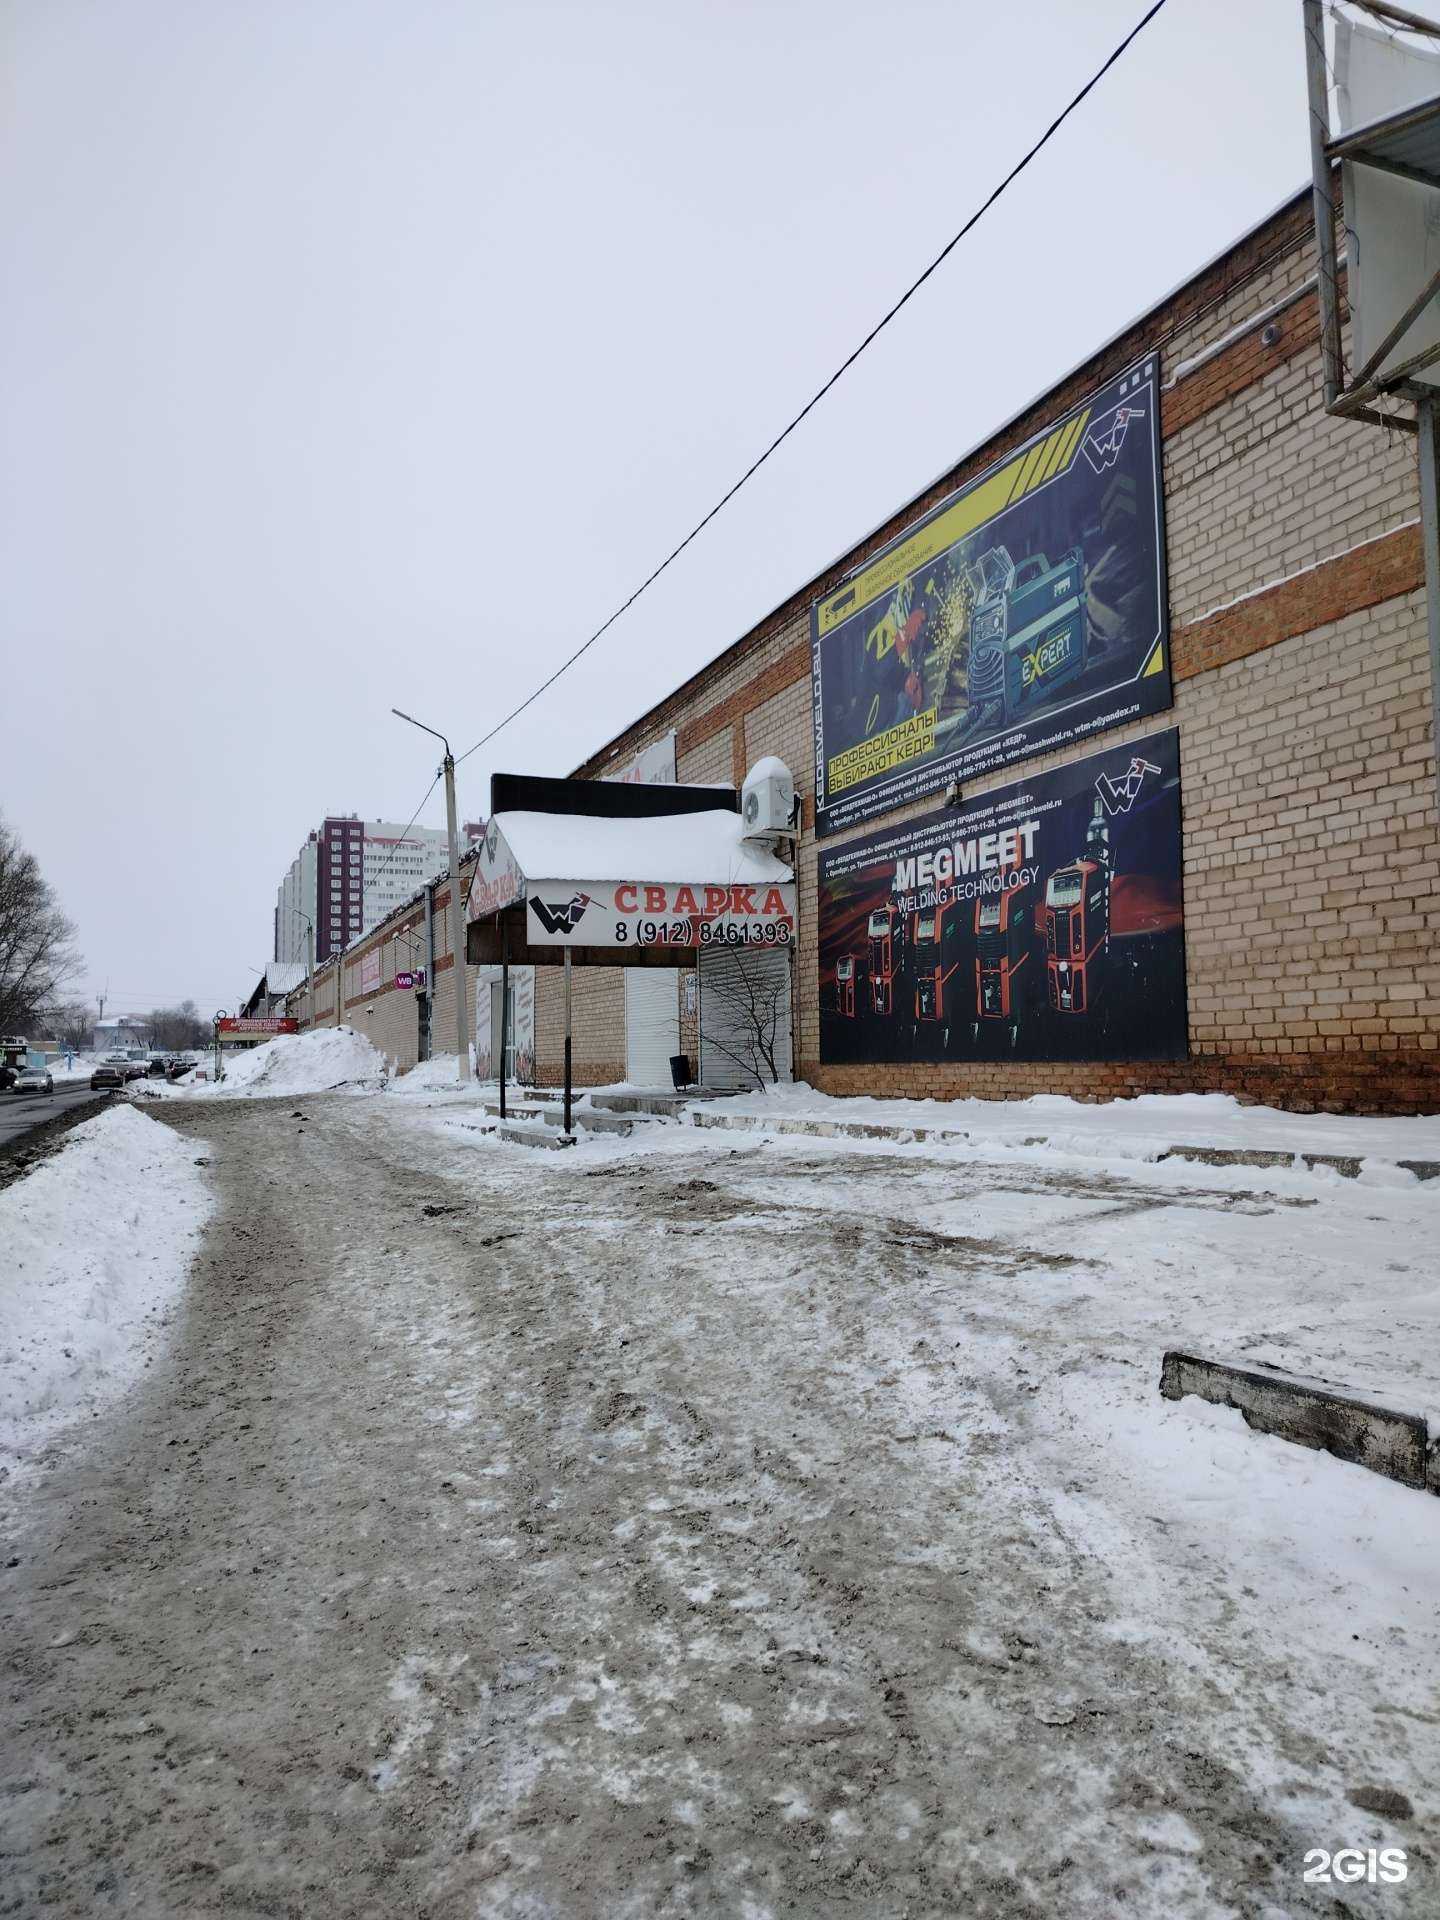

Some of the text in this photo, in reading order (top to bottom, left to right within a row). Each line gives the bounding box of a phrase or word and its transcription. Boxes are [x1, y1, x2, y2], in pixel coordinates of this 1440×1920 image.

[813, 639, 825, 812] KEDRWELD.RU
[829, 711, 937, 773] ПРОФЕССИОНАЛЫ
[1006, 730, 1073, 760] wtm-o@mashweld.ru,
[1074, 703, 1140, 733] wtm-o@yandex.ru
[829, 732, 935, 792] ВЫБИРАЮТ КЕДР!
[879, 778, 917, 798] ОФИЦИАЛЬНЫЙ
[918, 757, 963, 785] ДИСТРИБЬЮТОР
[964, 741, 1001, 764] ПРОДУКЦИИ
[1002, 733, 1027, 751] «КЕДР»
[912, 819, 957, 841] ДИСТРИБЬЮТОР
[957, 807, 994, 827] ПРОДУКЦИИ
[998, 799, 1063, 824] wtm-o@mashweld.ru
[896, 820, 1040, 892] MEGMEET
[614, 885, 787, 915] СВАРКА
[898, 865, 1040, 913] WELDING TECHNOLOGY
[615, 919, 791, 945] 8 (912) 8461393
